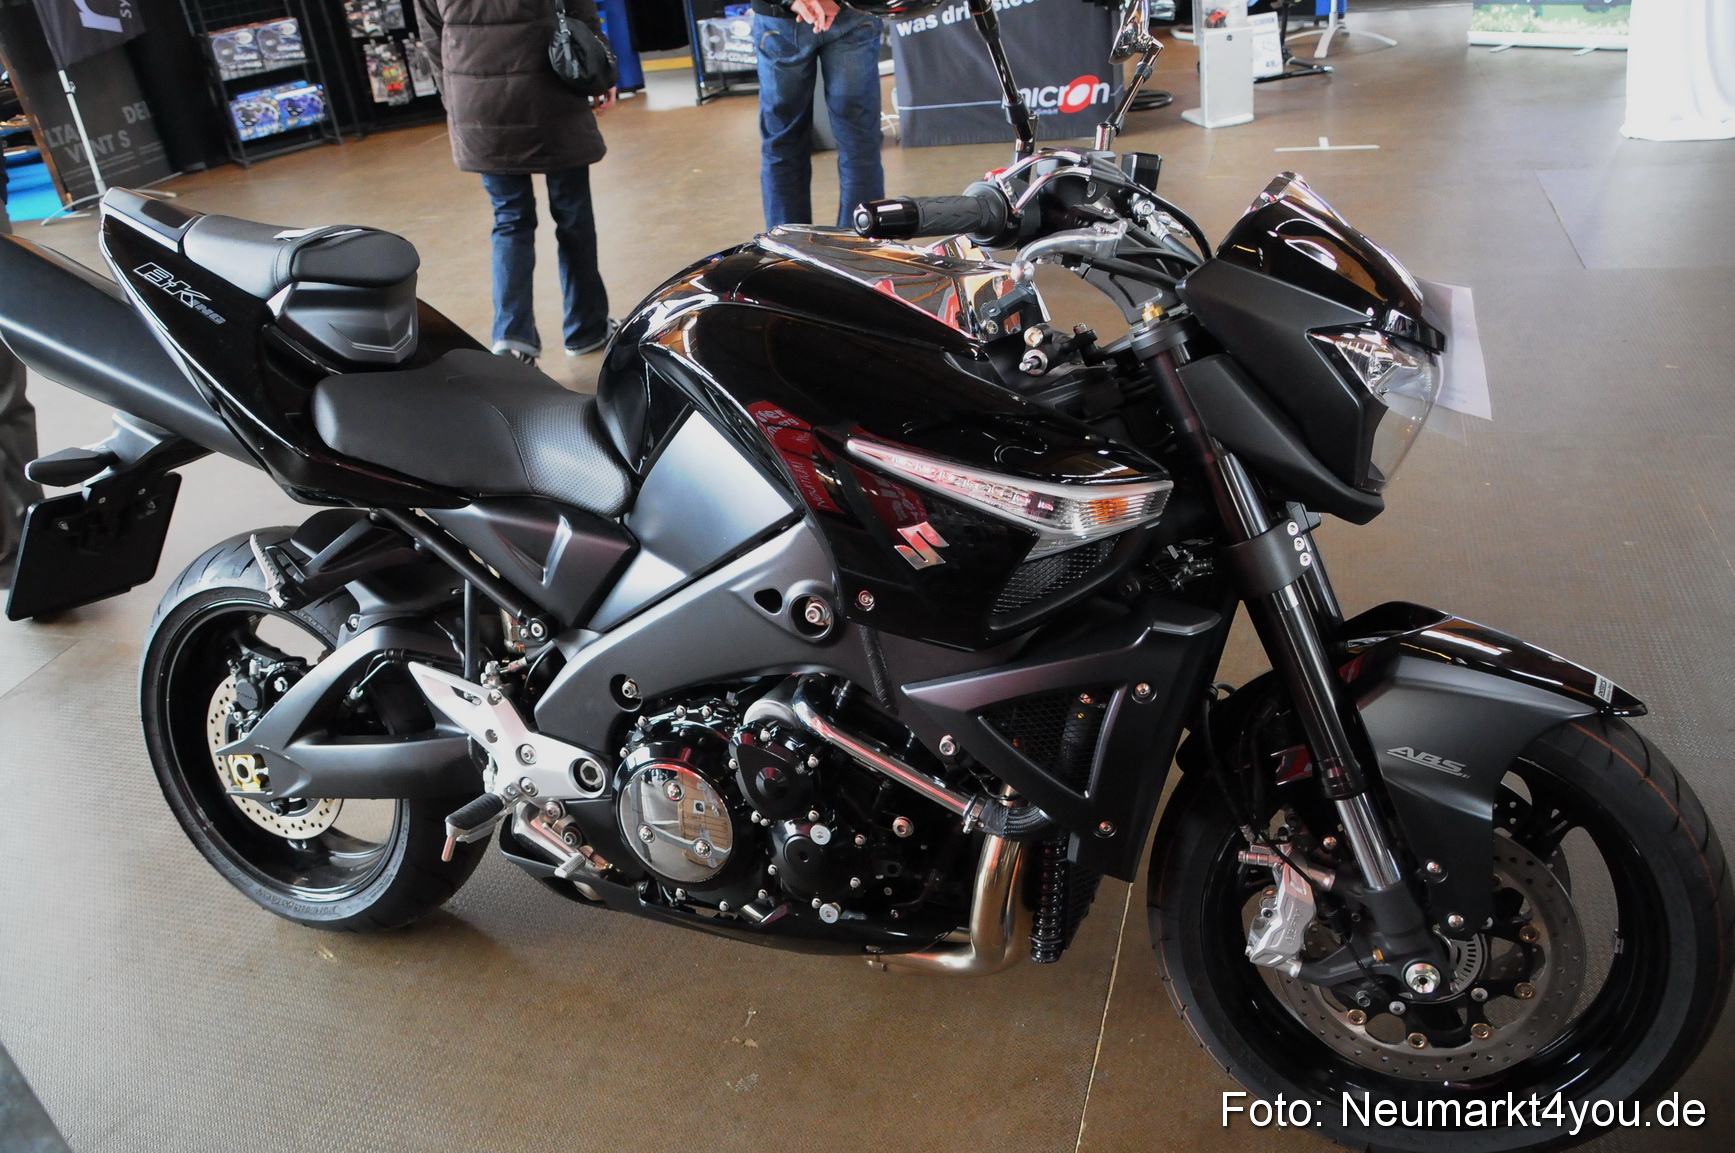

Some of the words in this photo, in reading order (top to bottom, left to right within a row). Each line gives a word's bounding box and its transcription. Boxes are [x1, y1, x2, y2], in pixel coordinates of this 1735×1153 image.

[896, 14, 939, 37] was
[65, 134, 115, 163] VNT
[1386, 746, 1467, 774] ABS
